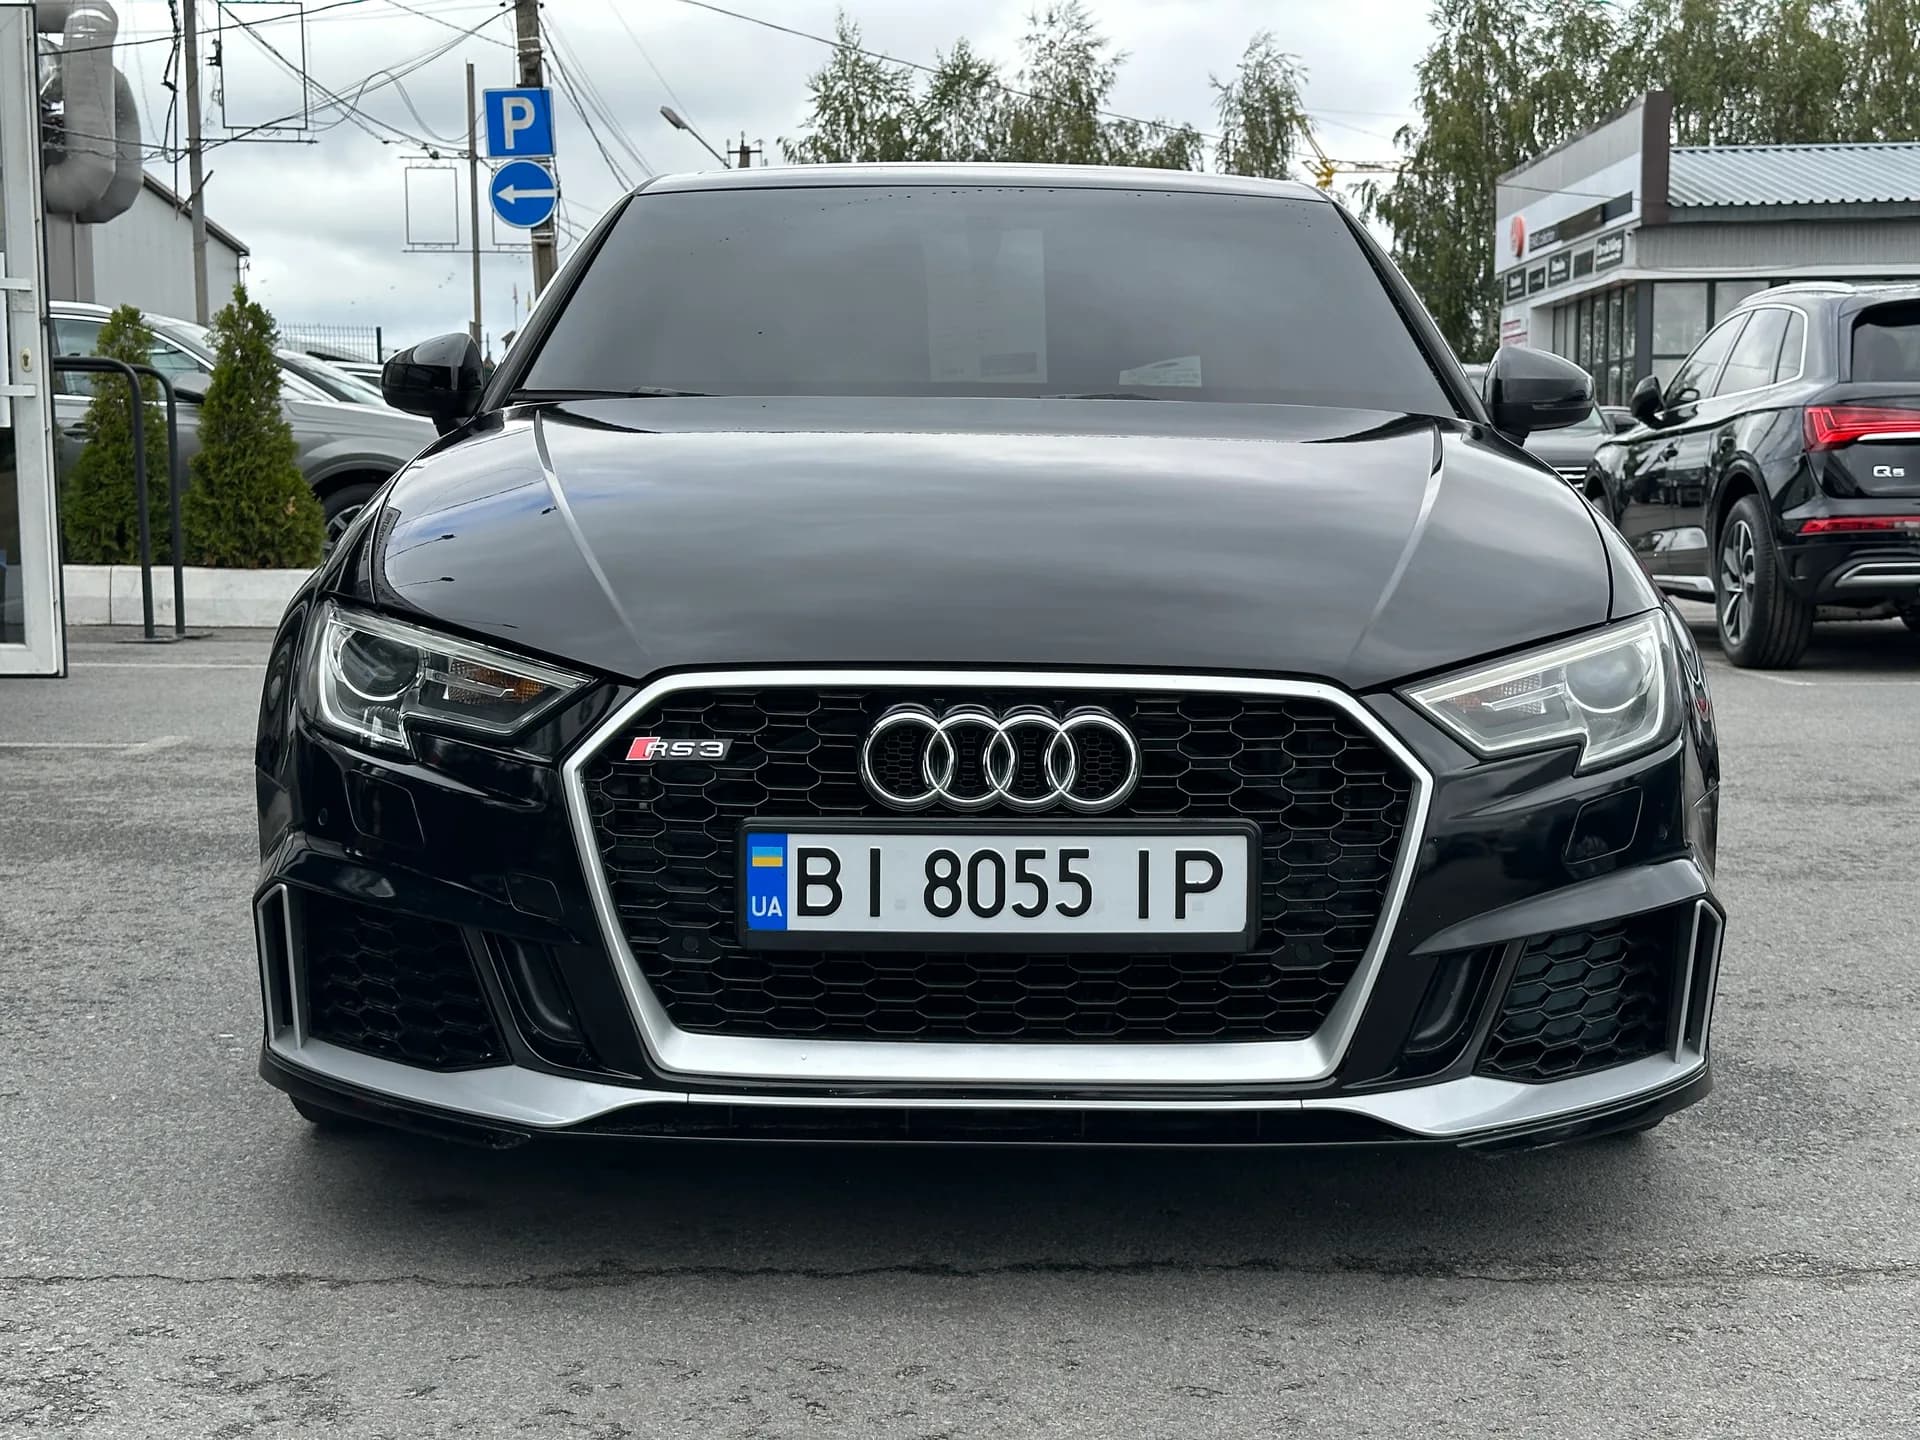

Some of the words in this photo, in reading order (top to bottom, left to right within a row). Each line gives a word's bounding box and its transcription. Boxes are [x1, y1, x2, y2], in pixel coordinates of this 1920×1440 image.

[502, 97, 535, 149] P
[751, 896, 783, 917] UA
[923, 847, 1093, 919] 8055
